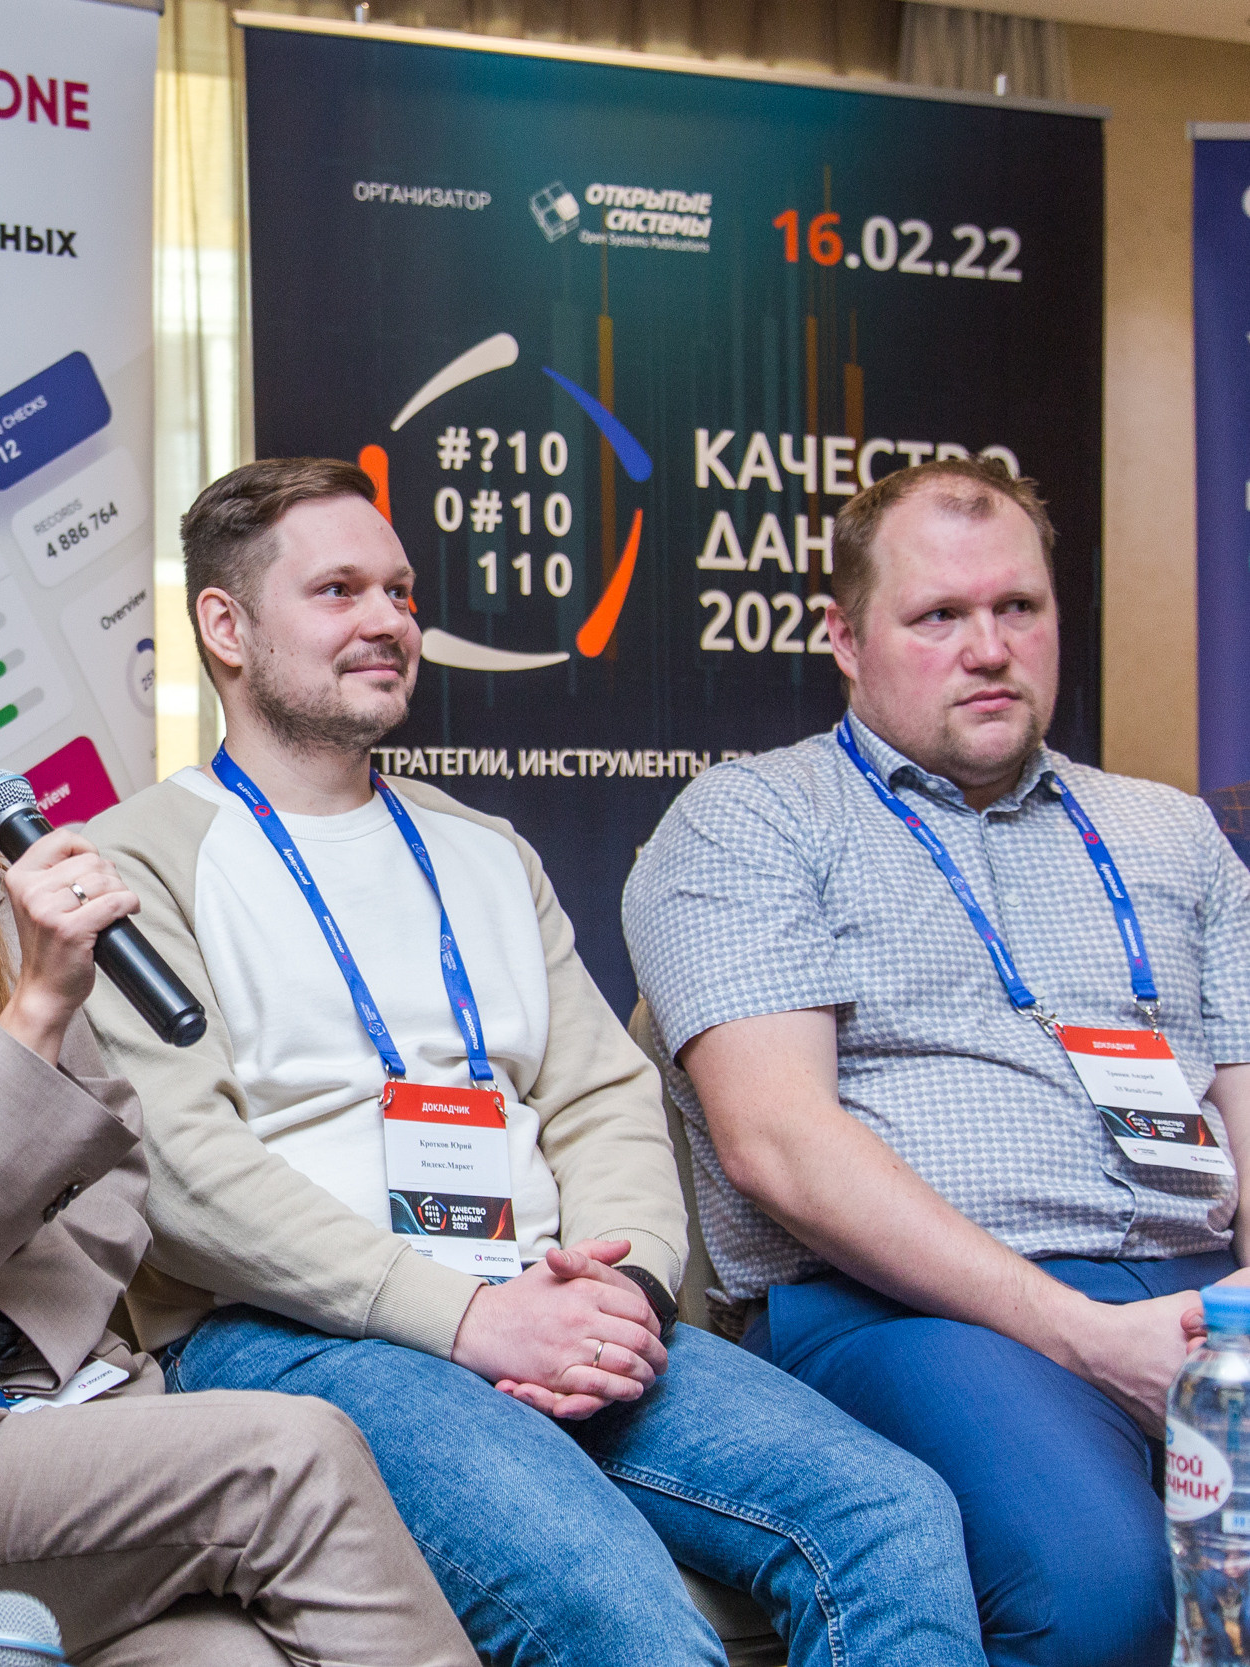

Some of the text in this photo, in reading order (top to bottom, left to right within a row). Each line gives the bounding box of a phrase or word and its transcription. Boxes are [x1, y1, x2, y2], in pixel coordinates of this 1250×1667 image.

[353, 181, 492, 211] ОРГАНИЗАТОР
[585, 183, 712, 215] ОТКРЫТЫЕ
[605, 209, 712, 238] СИСТЕМЫ
[772, 209, 1022, 282] 16.02.22
[2, 395, 48, 430] CHECKS
[47, 502, 118, 558] 4 886 764
[696, 510, 834, 574] ДАН
[477, 550, 573, 597] 110
[100, 589, 147, 630] Overview
[699, 590, 832, 654] 2022
[370, 747, 514, 780] ТРАТЕГИИ,
[37, 783, 71, 811] rview
[283, 848, 311, 885] precisely
[1100, 862, 1124, 900] precisely
[462, 1009, 479, 1050] ataccama
[421, 1102, 470, 1115] ДОКЛАДЧИК
[419, 1139, 472, 1152] Кротков Юрий
[450, 1205, 486, 1216] КАЧЕСТВО
[452, 1214, 482, 1223] ДАННЫХ
[452, 1222, 468, 1231] 2022
